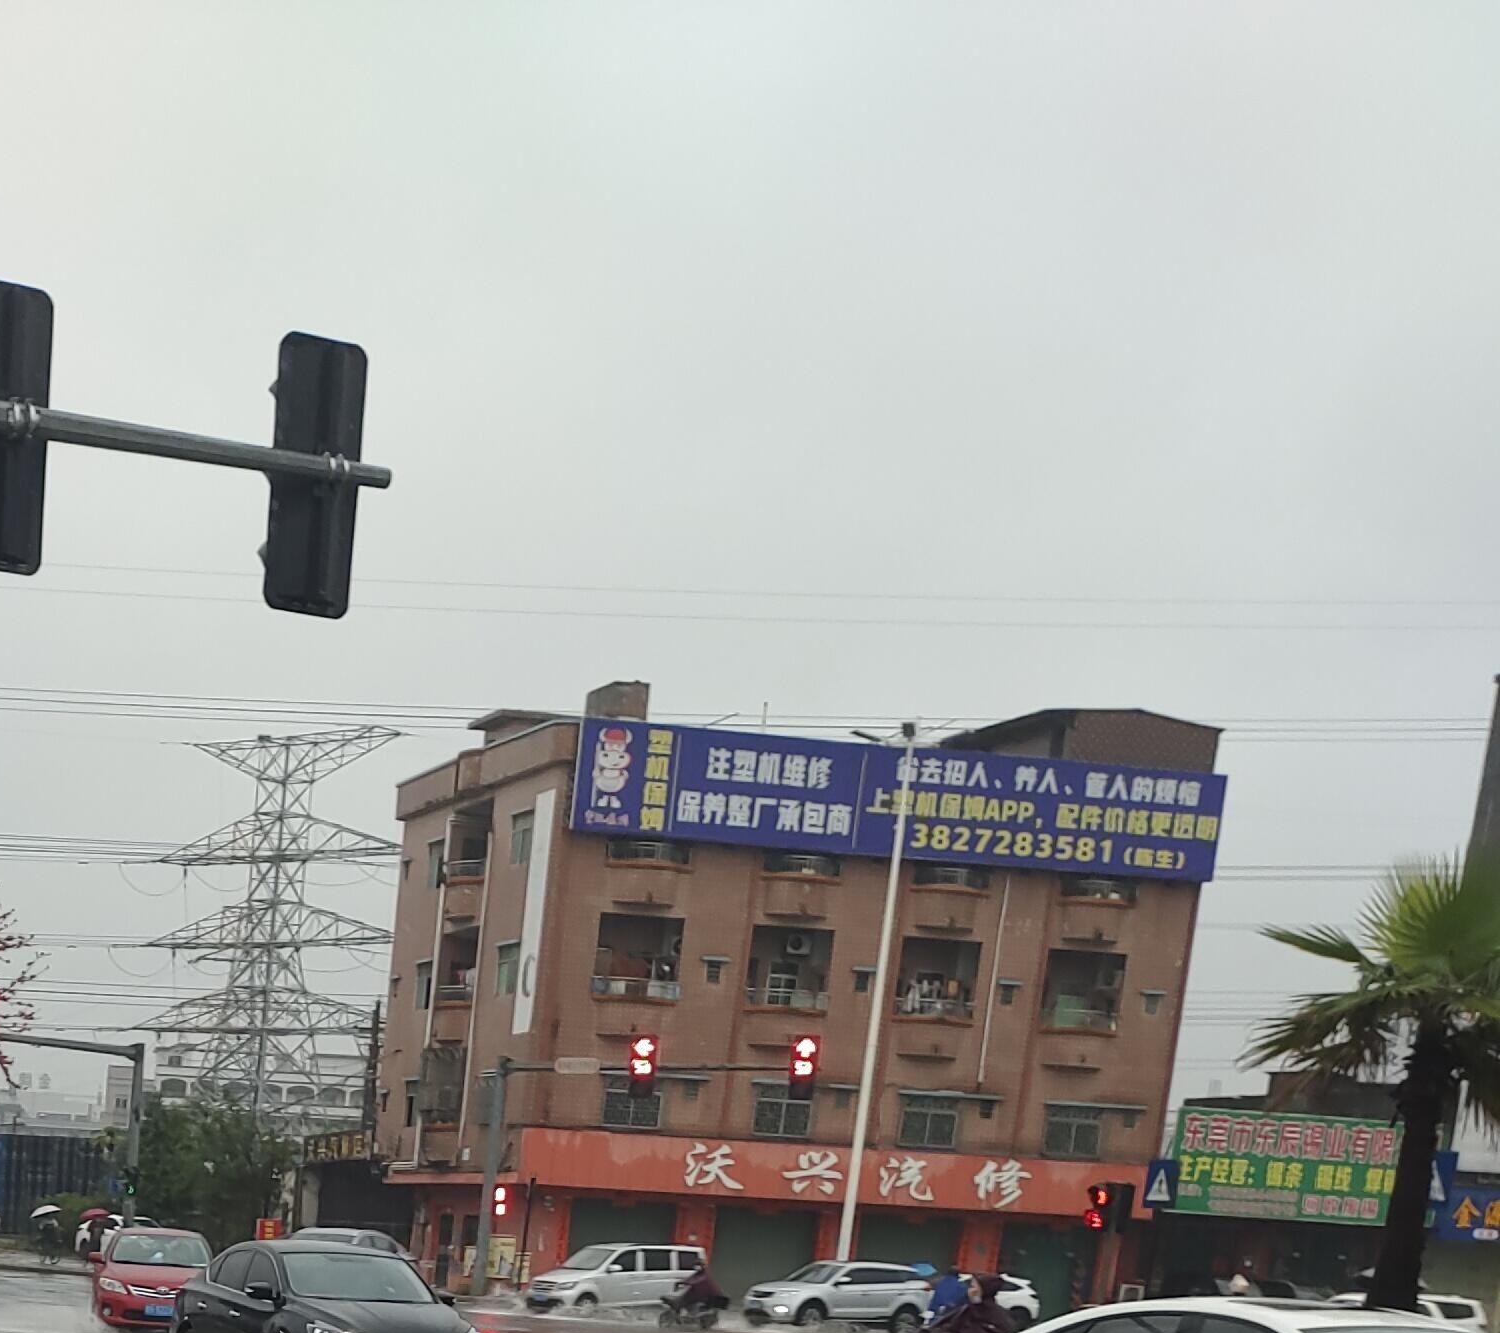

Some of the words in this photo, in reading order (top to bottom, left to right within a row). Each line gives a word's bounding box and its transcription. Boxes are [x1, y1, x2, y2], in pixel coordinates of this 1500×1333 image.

[706, 747, 834, 789] 注塑机维修
[677, 790, 853, 836] 保养整厂承包商
[893, 823, 1113, 864] 3827283581
[1180, 1114, 1403, 1166] 东莞市东辰锡业有限
[684, 1142, 1033, 1208] 沃兴汽修
